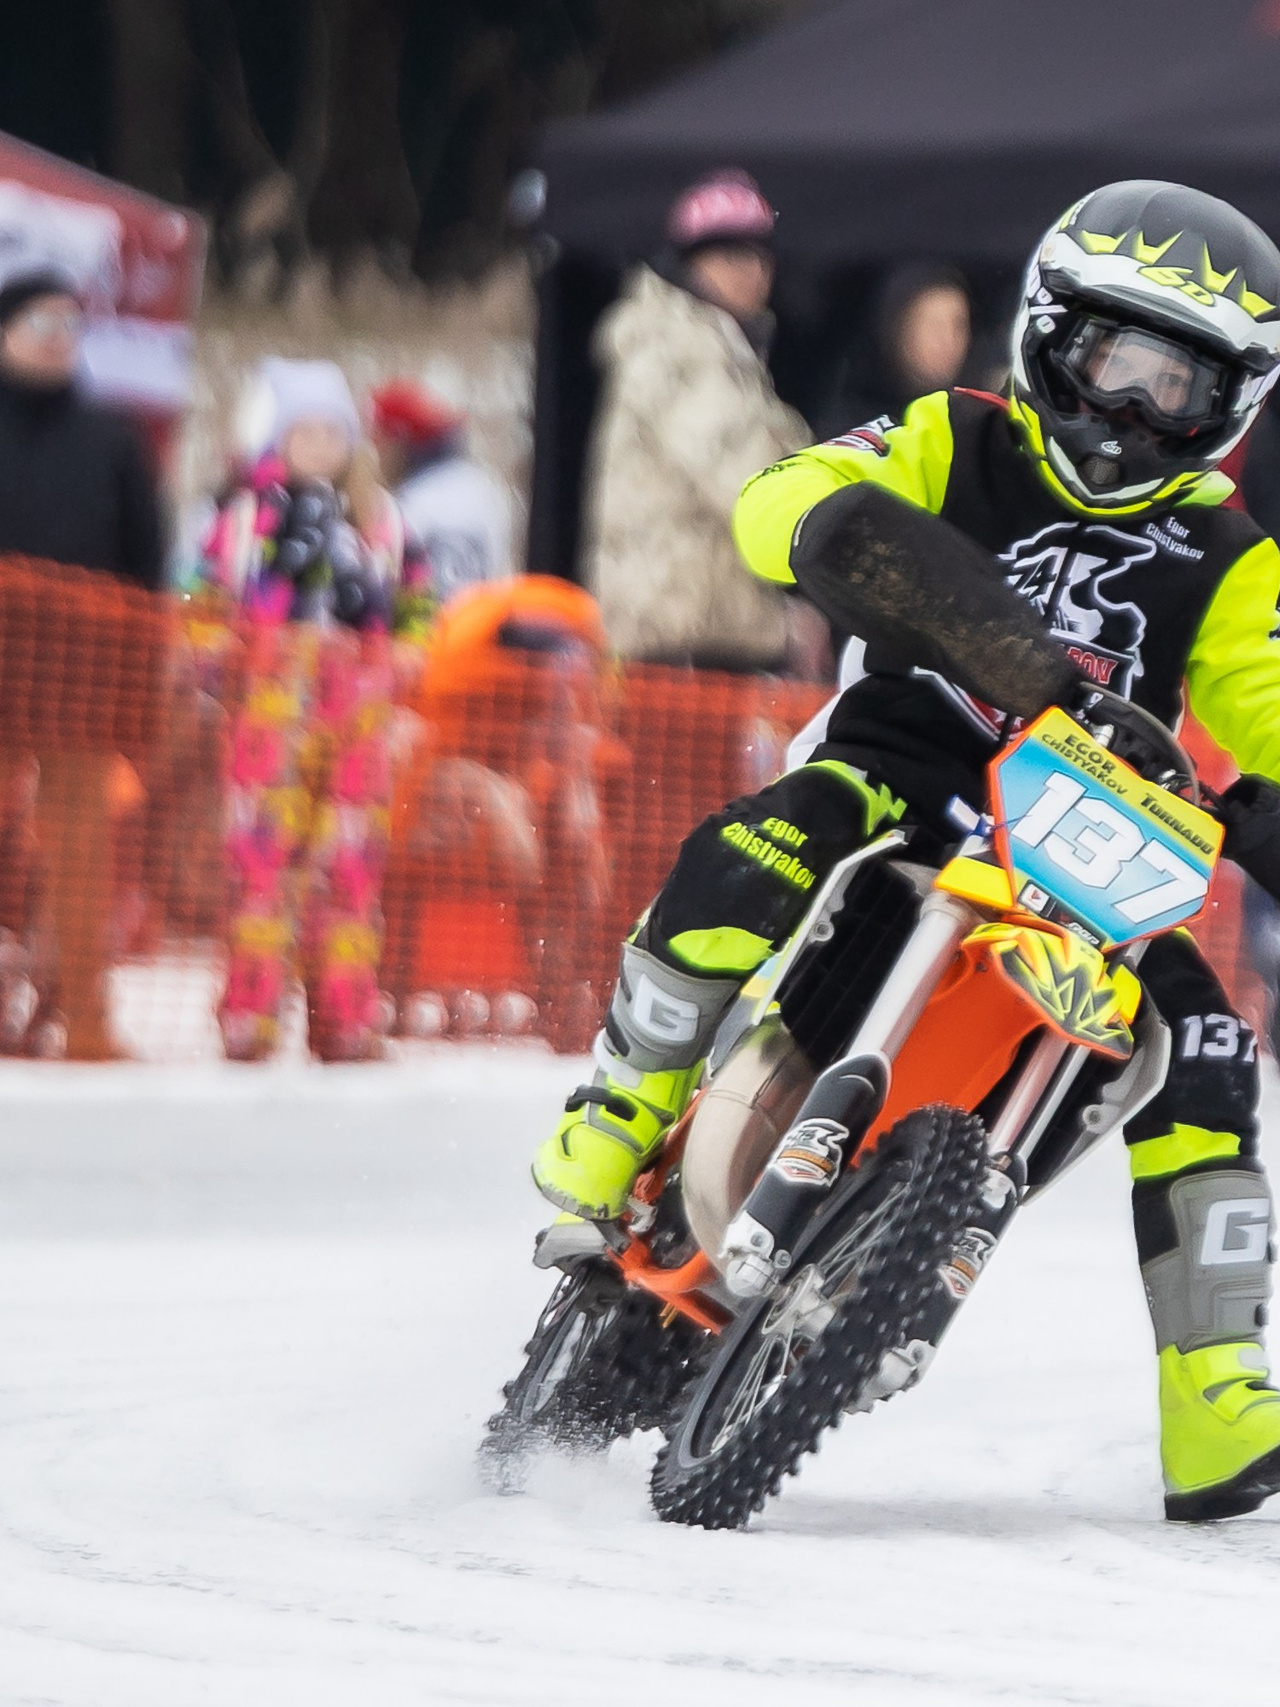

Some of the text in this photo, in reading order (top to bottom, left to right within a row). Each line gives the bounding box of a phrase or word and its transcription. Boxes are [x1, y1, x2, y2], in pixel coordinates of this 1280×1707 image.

[1041, 733, 1129, 795] CHISTYAKOV
[1064, 733, 1116, 775] EGOR
[762, 817, 809, 848] Egor
[1010, 770, 1209, 925] 137
[1201, 1197, 1270, 1265] G
